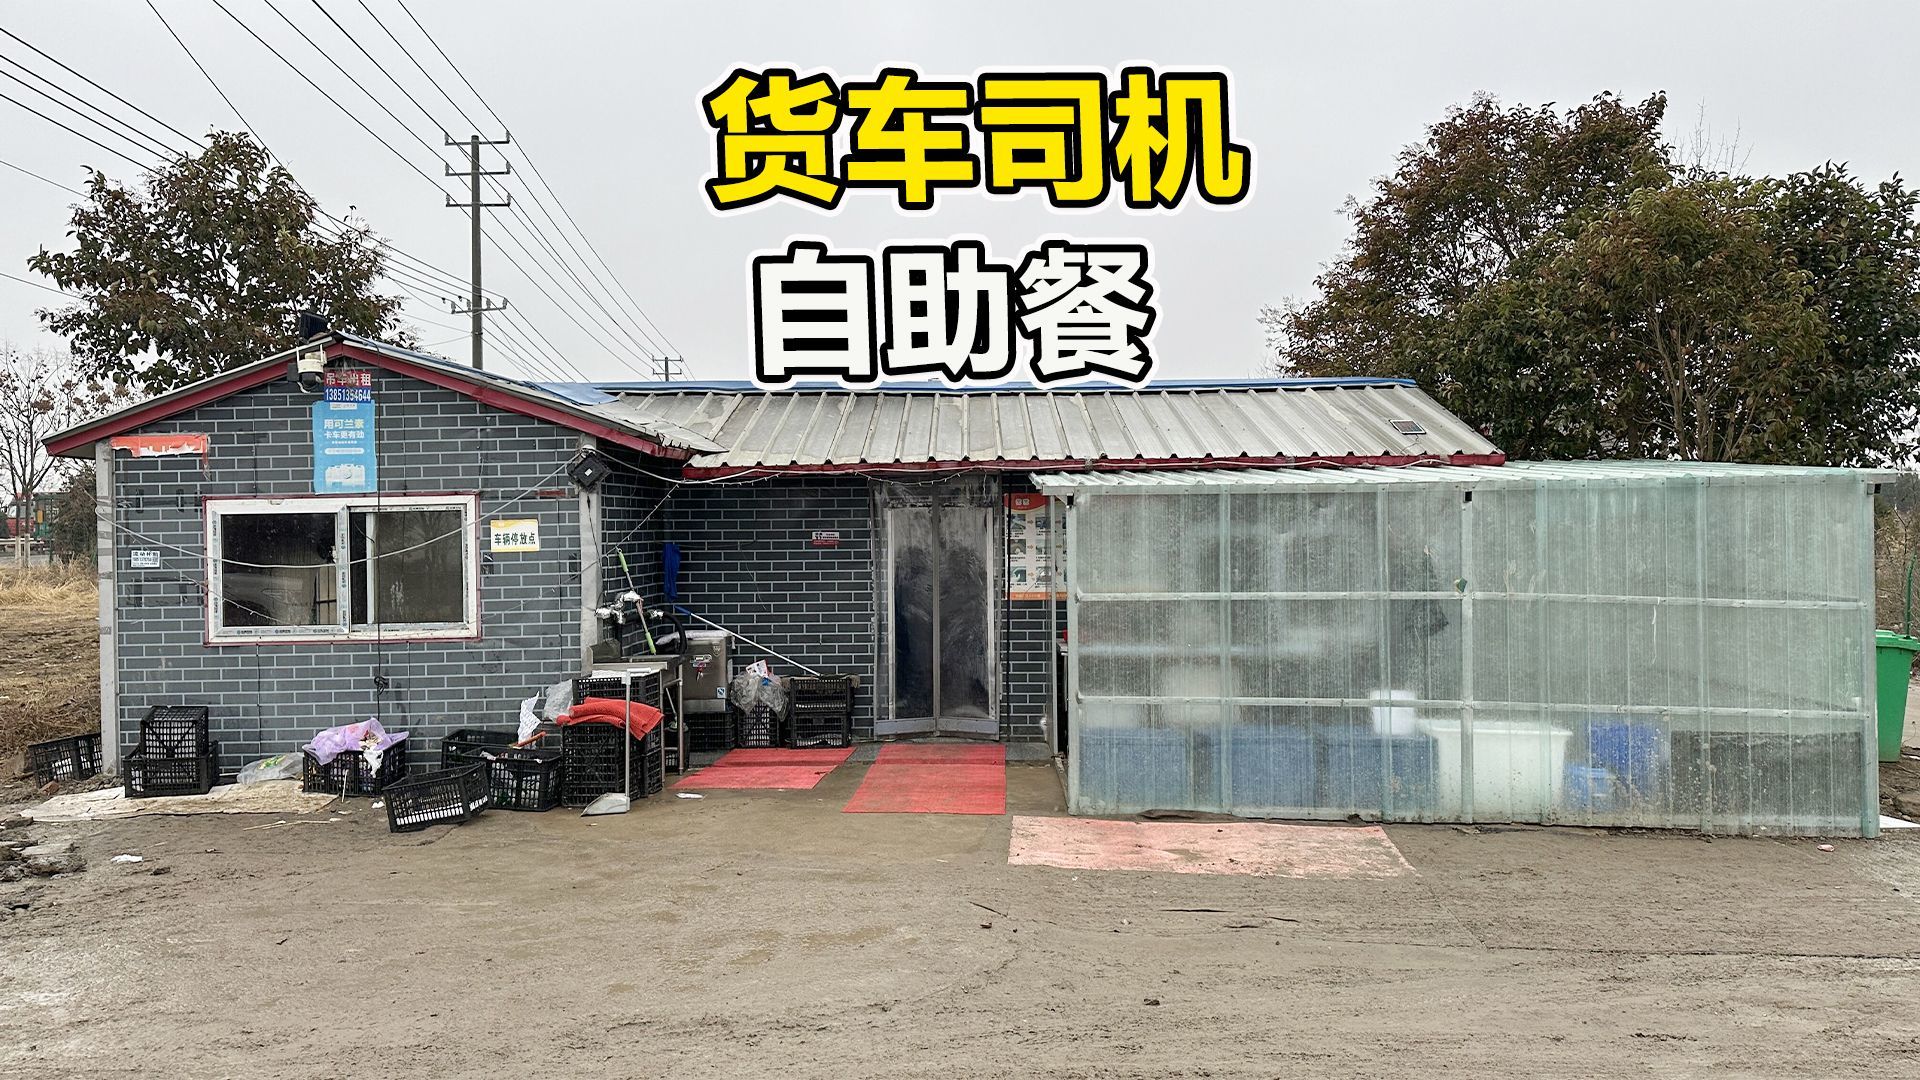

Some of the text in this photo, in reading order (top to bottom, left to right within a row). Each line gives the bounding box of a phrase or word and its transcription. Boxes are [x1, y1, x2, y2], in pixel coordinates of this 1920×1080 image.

[494, 532, 536, 546] 车辆停放点
